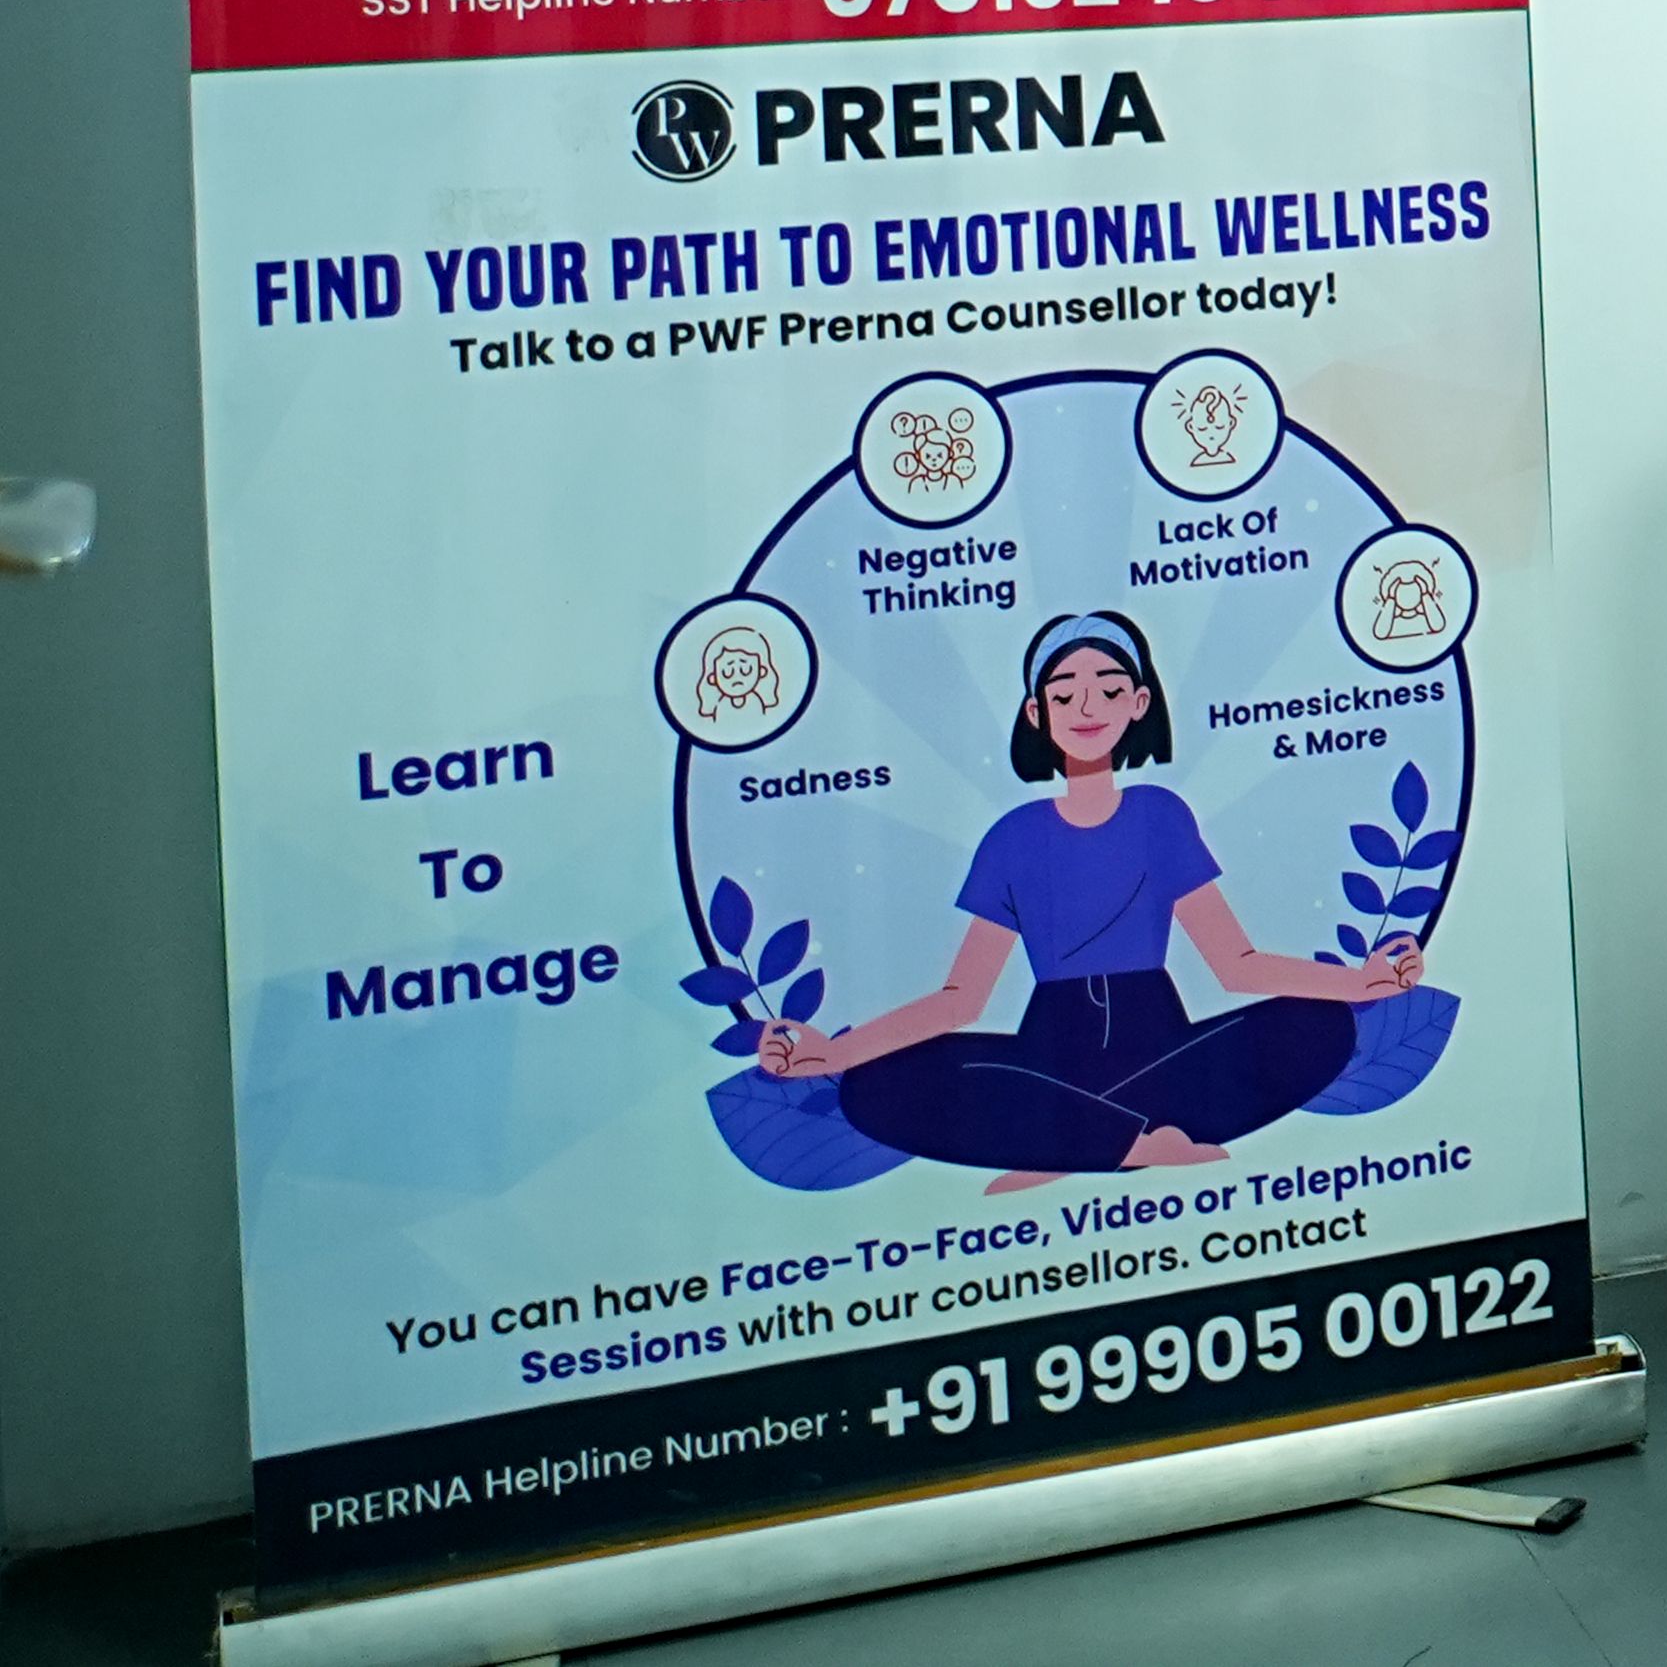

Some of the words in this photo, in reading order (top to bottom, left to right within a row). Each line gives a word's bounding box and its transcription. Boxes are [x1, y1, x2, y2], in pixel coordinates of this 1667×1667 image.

[756, 69, 1166, 167] PRERNA
[255, 253, 401, 327] FIND
[425, 241, 589, 315] YOUR
[611, 229, 760, 302] PATH
[780, 221, 853, 288] TO
[875, 201, 1196, 282] EMOTIONAL
[1214, 179, 1491, 259] WELLNESS
[450, 330, 555, 373] Talk
[568, 329, 614, 363] to
[626, 330, 656, 359] a
[669, 314, 768, 355] PWF
[780, 309, 934, 347] Prerna
[946, 286, 1187, 334] Counsellor
[1196, 272, 1337, 318] today!
[1157, 511, 1236, 546] Lack
[1242, 506, 1280, 537] Of
[857, 537, 1019, 581] Negative
[1129, 543, 1310, 587] Motivation
[863, 576, 1018, 617] Thinking
[1207, 679, 1446, 731] Homesickness
[357, 738, 555, 802] Learn
[1273, 733, 1298, 761] &
[1304, 724, 1388, 757] More
[738, 761, 892, 804] Sadness
[418, 848, 504, 900] To
[325, 942, 620, 1021] Manage
[386, 1311, 477, 1355] You
[490, 1296, 579, 1335] can
[594, 1272, 709, 1320] have
[721, 1218, 1051, 1298] Face-To-Face,
[1061, 1191, 1185, 1236] Video
[1193, 1182, 1237, 1215] or
[1247, 1139, 1473, 1205] Telephonic
[520, 1323, 727, 1385] Sessions
[738, 1297, 833, 1348] with
[846, 1289, 919, 1328] our
[931, 1241, 1189, 1313] counsellors.
[1200, 1206, 1367, 1264] Contact
[309, 1475, 472, 1534] PRERNA
[485, 1443, 654, 1499] Helpline
[664, 1406, 828, 1468] Number
[870, 1357, 1010, 1438] +91
[1034, 1303, 1303, 1413] 99905
[1325, 1258, 1554, 1358] 00122
